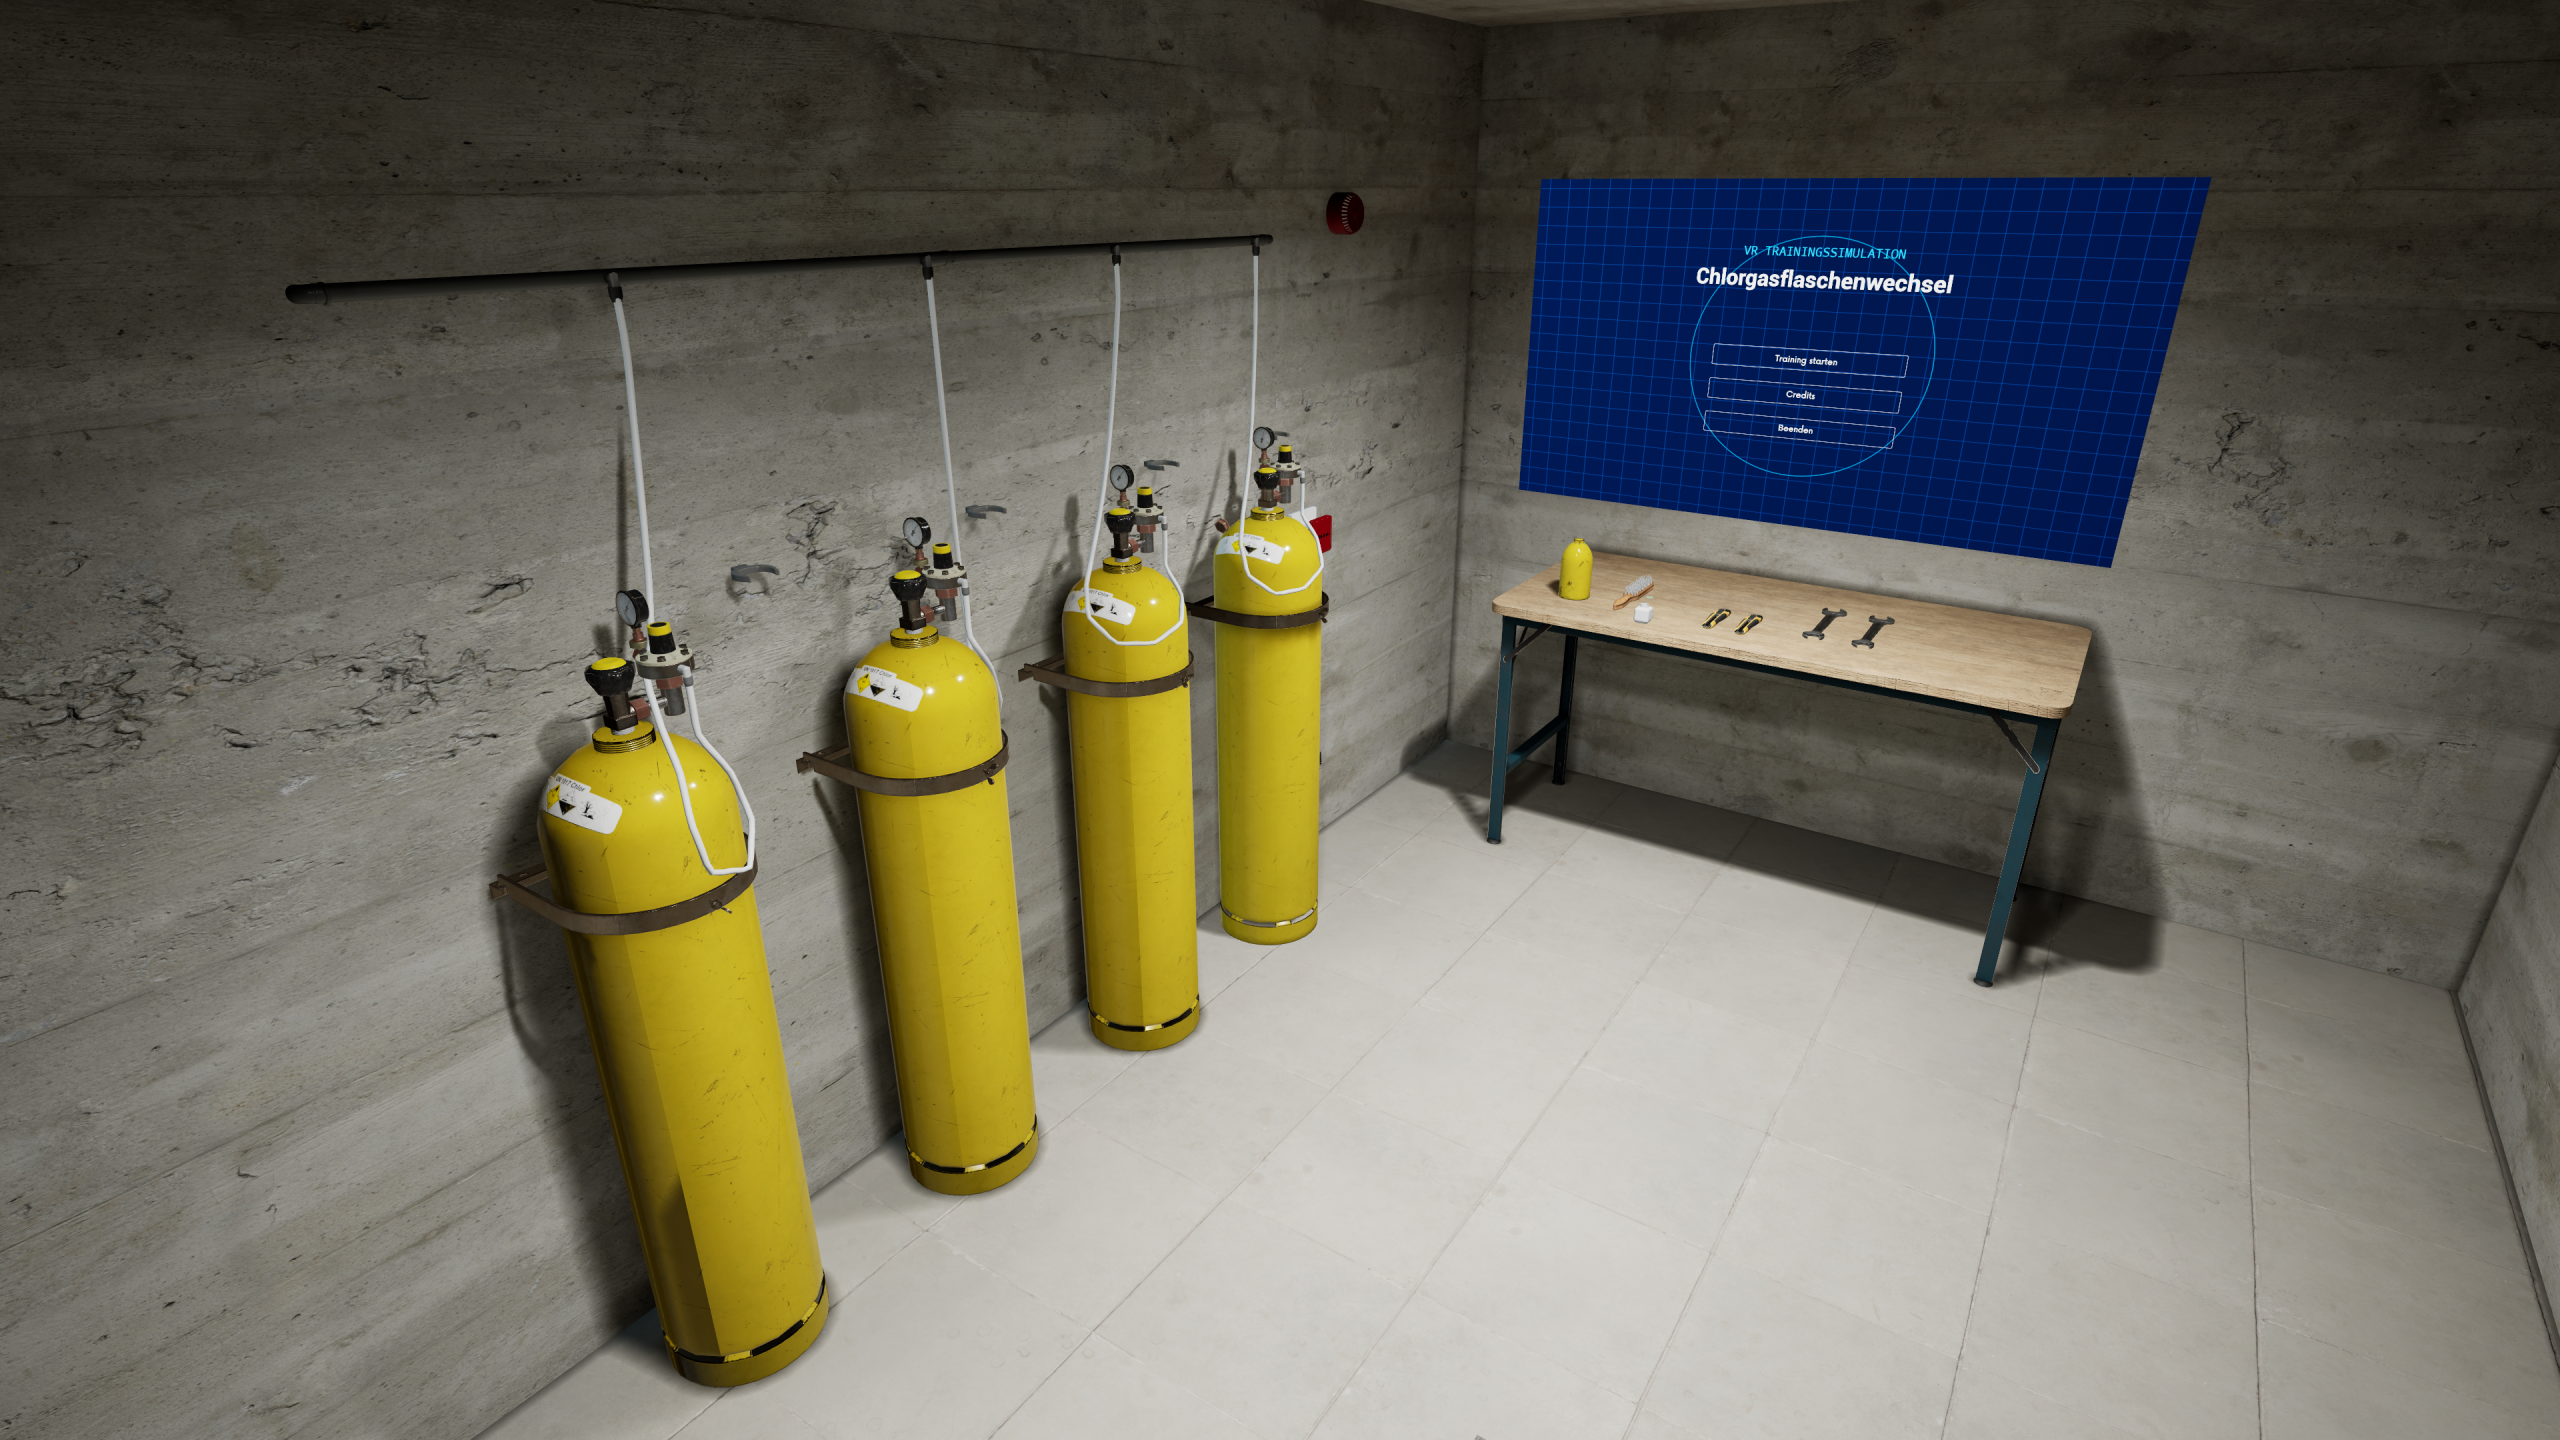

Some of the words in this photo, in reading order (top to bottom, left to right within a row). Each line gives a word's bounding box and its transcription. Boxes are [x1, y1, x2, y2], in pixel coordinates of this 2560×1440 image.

[1744, 245, 1759, 256] VR
[1766, 246, 1907, 260] TRAININGSSIMULATION
[1696, 267, 1954, 294] Chlorgasflaschenwechsel
[1775, 354, 1807, 366] Training
[1809, 357, 1838, 366] starten
[1786, 390, 1816, 400] Credits
[1778, 424, 1813, 434] Beenden
